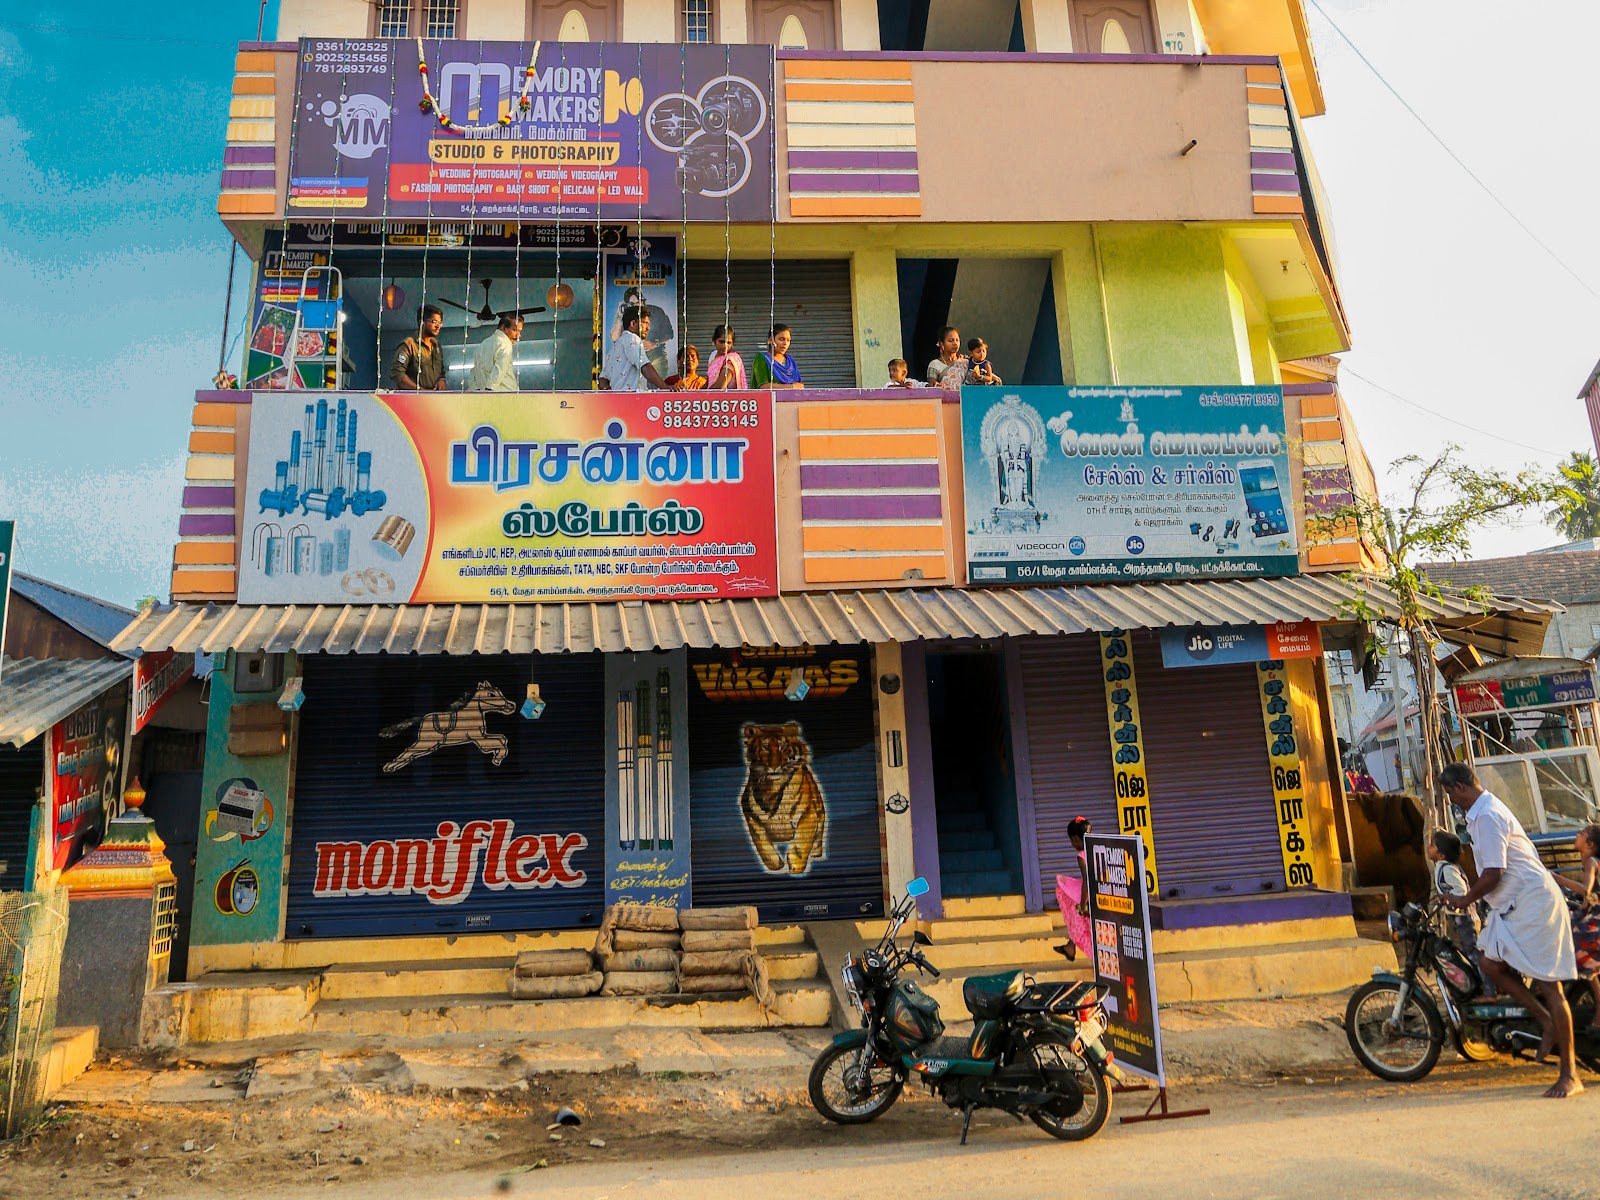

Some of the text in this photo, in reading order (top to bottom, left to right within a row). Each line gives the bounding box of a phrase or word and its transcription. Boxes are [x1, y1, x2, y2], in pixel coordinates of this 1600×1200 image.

[316, 42, 388, 51] 9361702525
[315, 53, 388, 63] 9025255456
[314, 64, 387, 74] 7812893749
[511, 95, 600, 123] MAKERS
[332, 118, 389, 146] MM
[434, 144, 614, 161] STUDIO & PHOTOGRAPHY
[439, 168, 523, 179] WEDDING PHOTOGRAPHY
[536, 170, 618, 180] WEDDING VIDEOGRAPHY
[411, 183, 493, 194] FASHION PHOTOGRAPHY
[506, 184, 550, 194] BABY SHOOT
[563, 185, 595, 195] HELICAM
[607, 185, 644, 196] LED WALL
[663, 399, 758, 414] 8525056768
[663, 414, 758, 429] 9843733145
[450, 420, 747, 491] பிரசன்னா
[1084, 460, 1236, 487] சேல்ஸ் & சர்வீஸ்
[1076, 492, 1120, 503] அனைத்து
[1121, 492, 1165, 502] செல்போன்
[1086, 507, 1100, 515] DTH
[1185, 504, 1228, 515] கிடைக்கும்
[502, 500, 704, 538] ஸ்பேர்ஸ்
[1134, 519, 1141, 527] &
[1128, 539, 1143, 550] Jio
[500, 547, 516, 560] HEP,
[574, 563, 595, 576] TATA,
[596, 563, 613, 576] NBC,
[615, 562, 629, 575] SKF
[1042, 564, 1066, 578] மேதா
[1275, 624, 1296, 633] MNP
[1188, 635, 1213, 651] Jio
[1217, 635, 1245, 643] DIGITAL
[1277, 633, 1309, 643] சேவை
[1279, 643, 1311, 653] மையம்
[313, 818, 588, 905] moniflex
[1125, 974, 1139, 1023] 5
